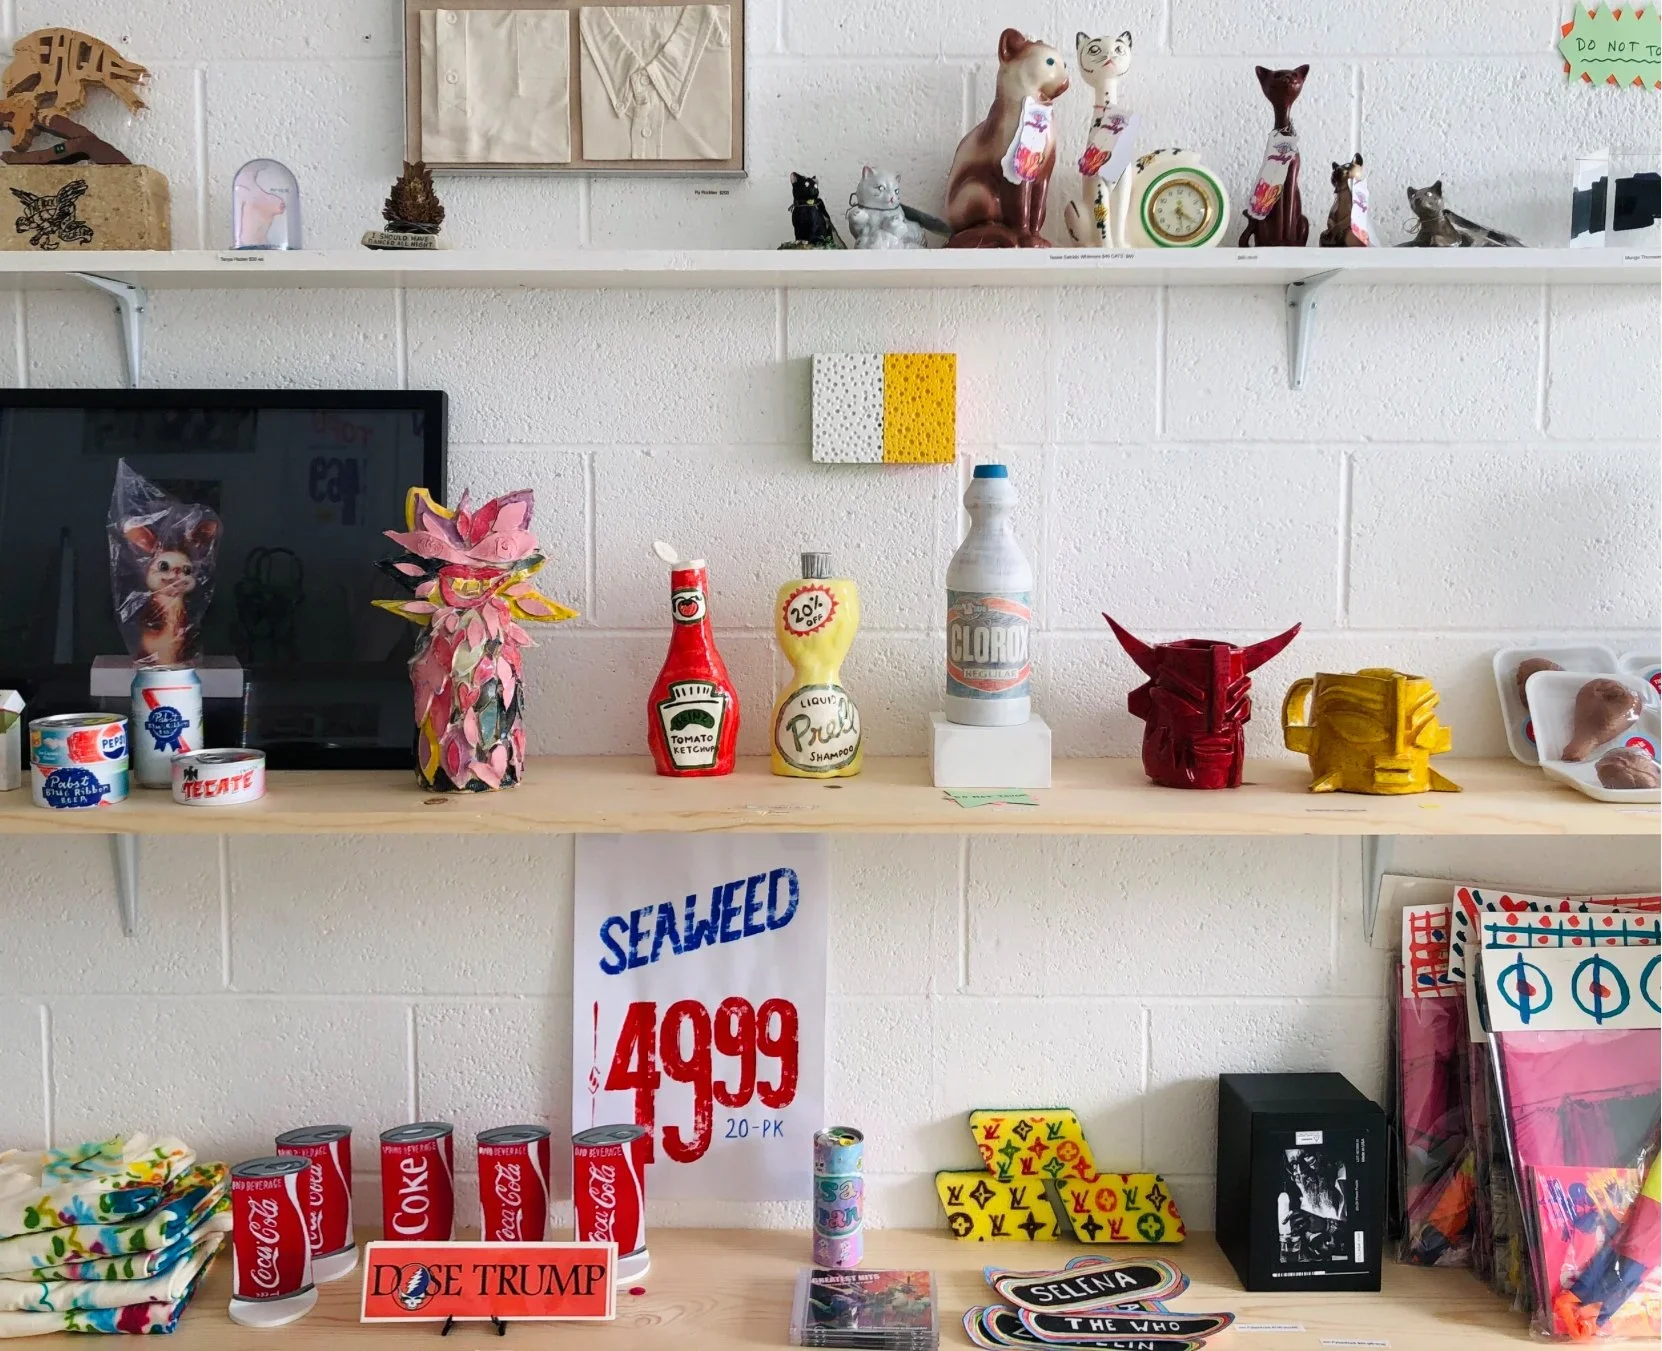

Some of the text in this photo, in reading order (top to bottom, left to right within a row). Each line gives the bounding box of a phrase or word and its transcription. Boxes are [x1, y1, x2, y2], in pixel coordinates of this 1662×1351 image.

[1575, 37, 1661, 57] DO NOT TO
[380, 233, 408, 241] SHOULD
[790, 594, 823, 624] 20%
[806, 613, 823, 627] OFF
[951, 623, 1028, 663] CLOROX
[800, 695, 837, 708] LIQUID
[786, 697, 858, 752] Prell
[671, 734, 713, 745] TOMATO
[673, 745, 716, 755] KETCHUP
[809, 745, 854, 762] SHAMPOO
[50, 775, 89, 789] Pabst
[74, 783, 109, 797] Ribbon
[183, 769, 254, 799] TECATE
[599, 866, 800, 975] SEAWEED
[724, 1118, 785, 1139] 20-PK
[245, 1178, 282, 1191] BEVERAGE
[392, 1155, 430, 1236] Coke
[473, 1264, 606, 1297] TRUMP
[811, 1274, 857, 1285] GREATEST
[858, 1273, 881, 1281] HITS
[1030, 1271, 1137, 1302] SELENA
[1064, 1317, 1181, 1332] THE WHO
